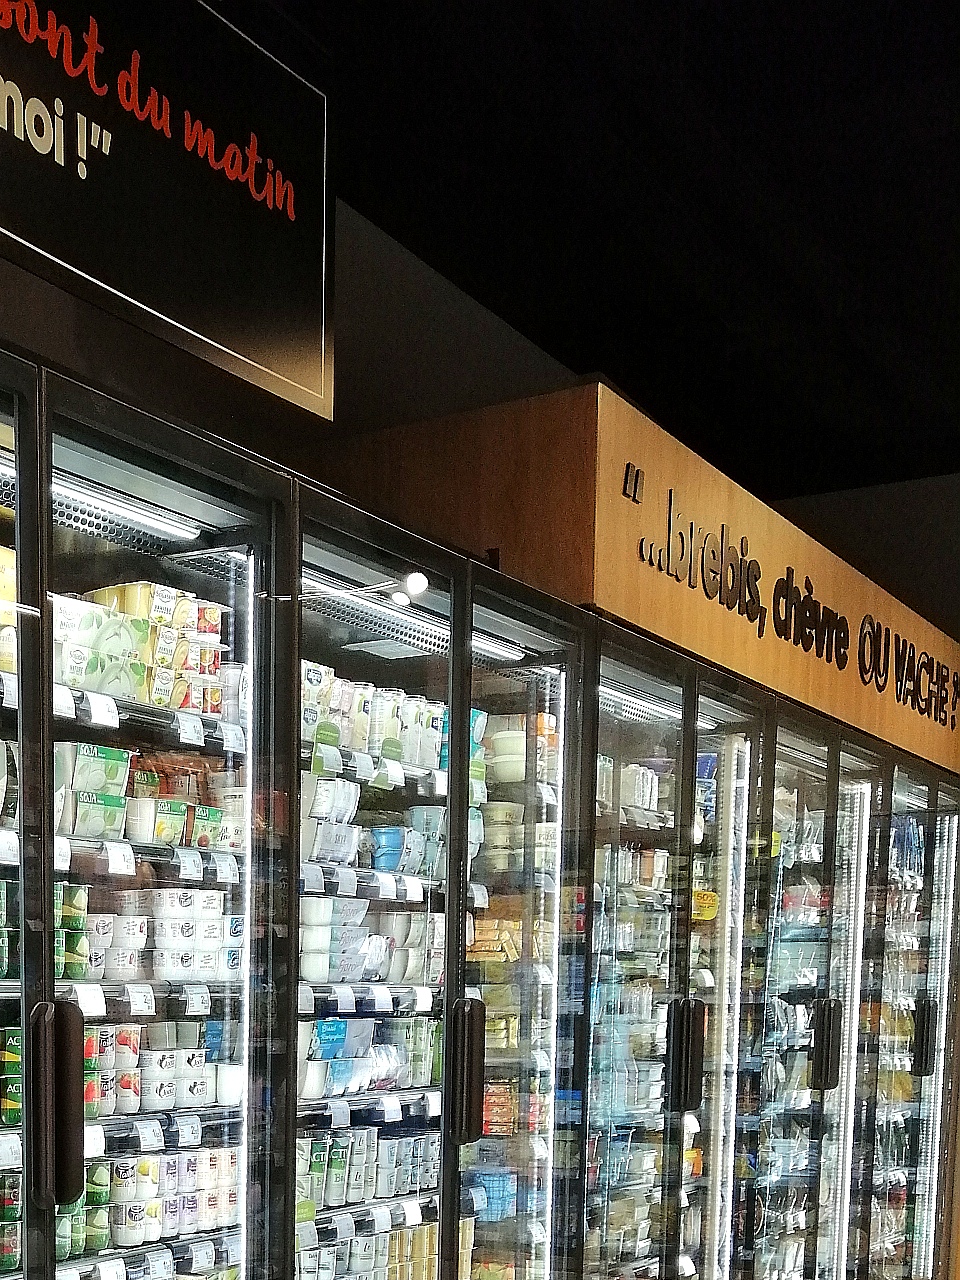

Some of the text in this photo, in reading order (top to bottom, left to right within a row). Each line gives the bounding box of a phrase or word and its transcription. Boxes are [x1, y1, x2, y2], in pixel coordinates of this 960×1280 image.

[118, 51, 170, 138] du
[185, 110, 295, 221] matin
[772, 566, 850, 671] chèvre
[858, 613, 890, 692] OU
[894, 633, 950, 727] VACHE
